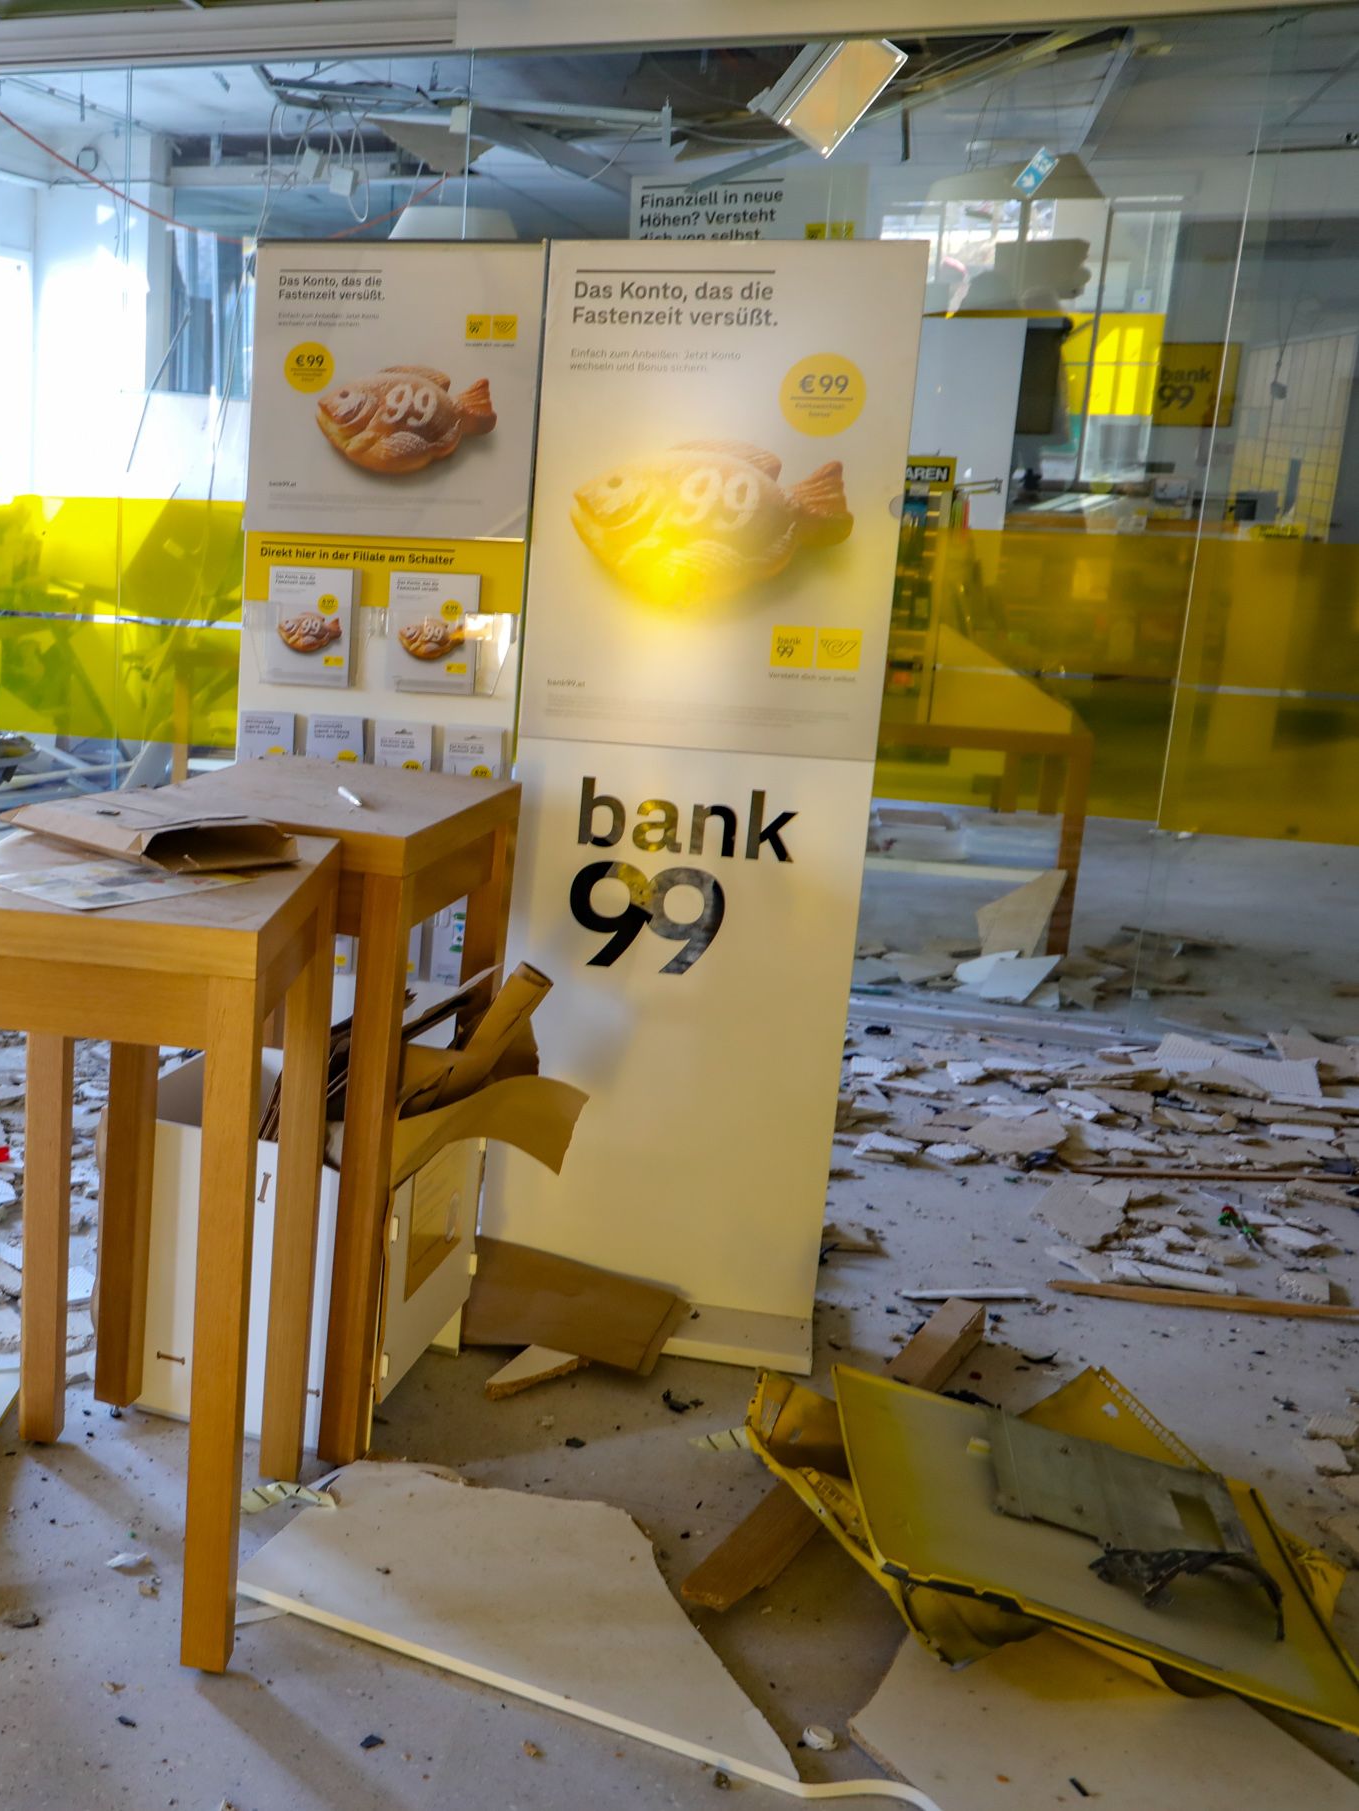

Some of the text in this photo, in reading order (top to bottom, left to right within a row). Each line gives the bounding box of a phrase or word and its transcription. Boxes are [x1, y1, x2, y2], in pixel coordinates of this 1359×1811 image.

[640, 189, 784, 208] Finanziell in neue
[639, 208, 776, 228] Höhen? Versteht
[279, 275, 383, 288] Das Konto, das die
[574, 281, 774, 303] Das Konto, das die
[278, 289, 386, 301] Fastenzeit versüßt.
[572, 305, 779, 327] Fastenzeit versüßt.
[380, 383, 438, 427] 99
[670, 467, 760, 531] 99
[260, 546, 456, 566] Direkt hier in der Filiale am Schalter
[578, 776, 799, 863] bank
[570, 860, 725, 974] 99
